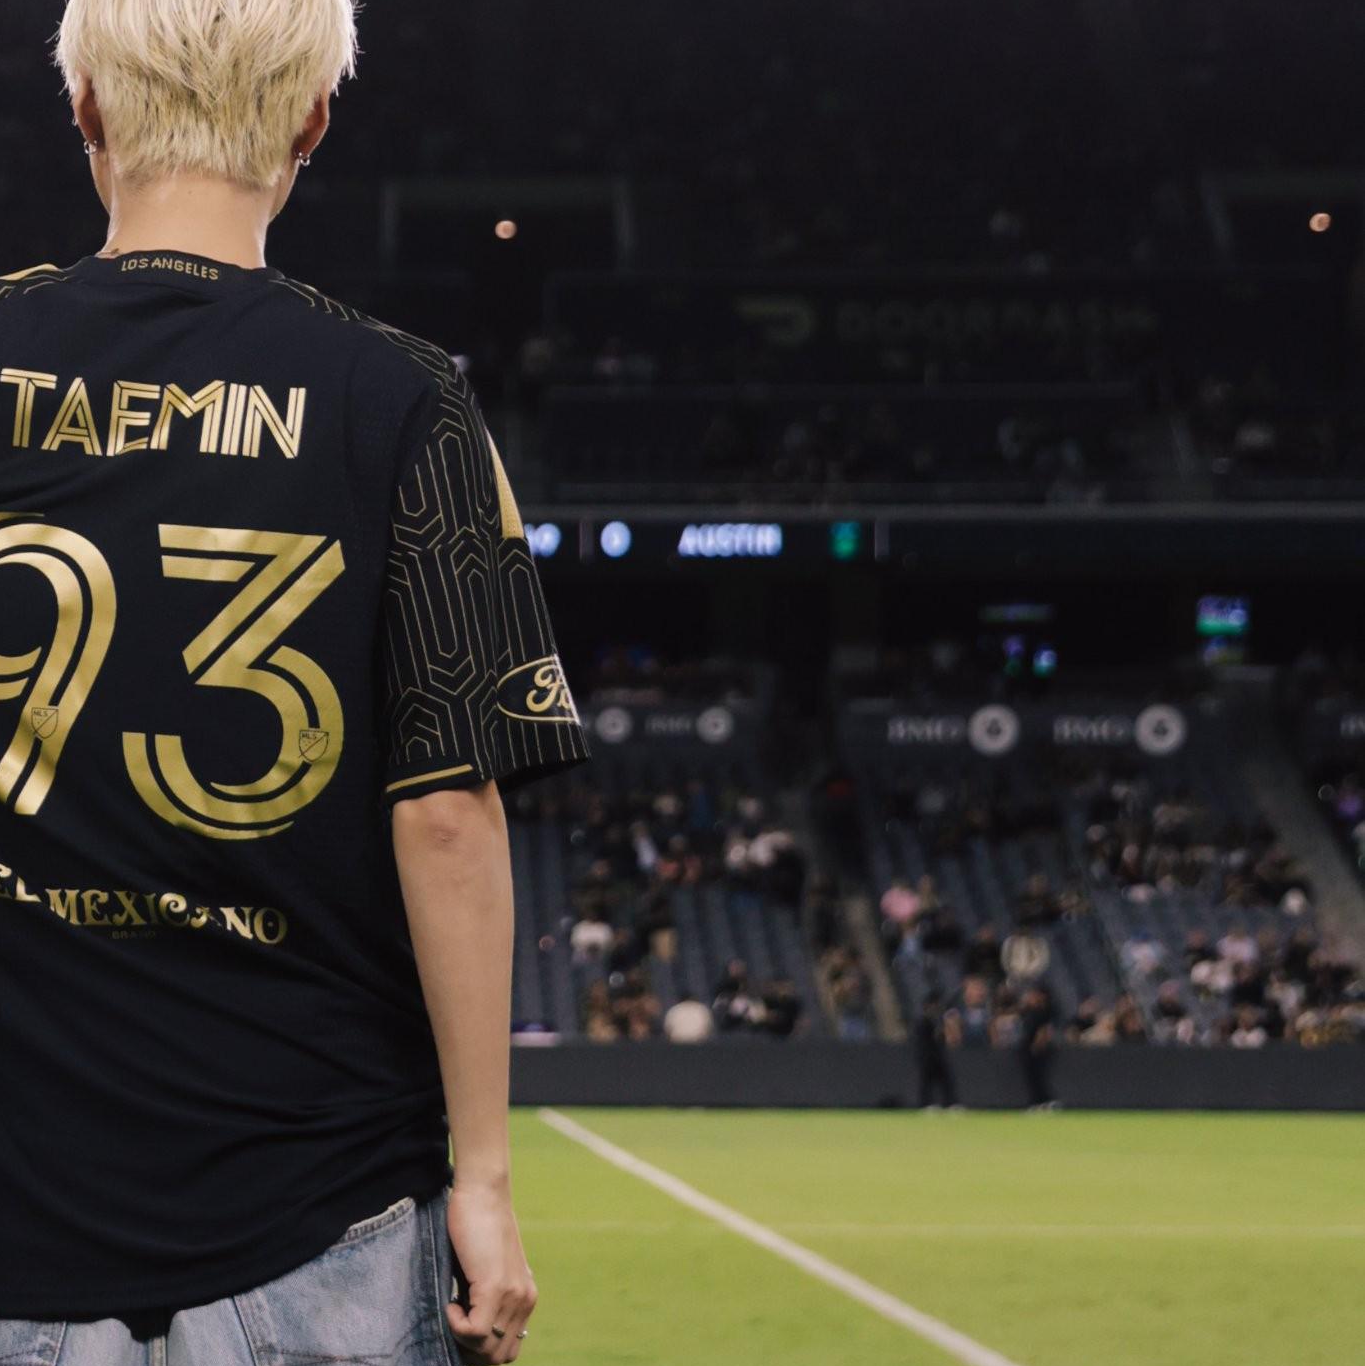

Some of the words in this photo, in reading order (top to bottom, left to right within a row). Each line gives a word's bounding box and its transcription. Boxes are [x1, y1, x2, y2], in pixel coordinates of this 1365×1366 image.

[121, 258, 149, 272] LOS
[151, 257, 219, 280] ANGELES
[0, 368, 306, 459] TAEMIN
[678, 523, 783, 557] AUSTIN
